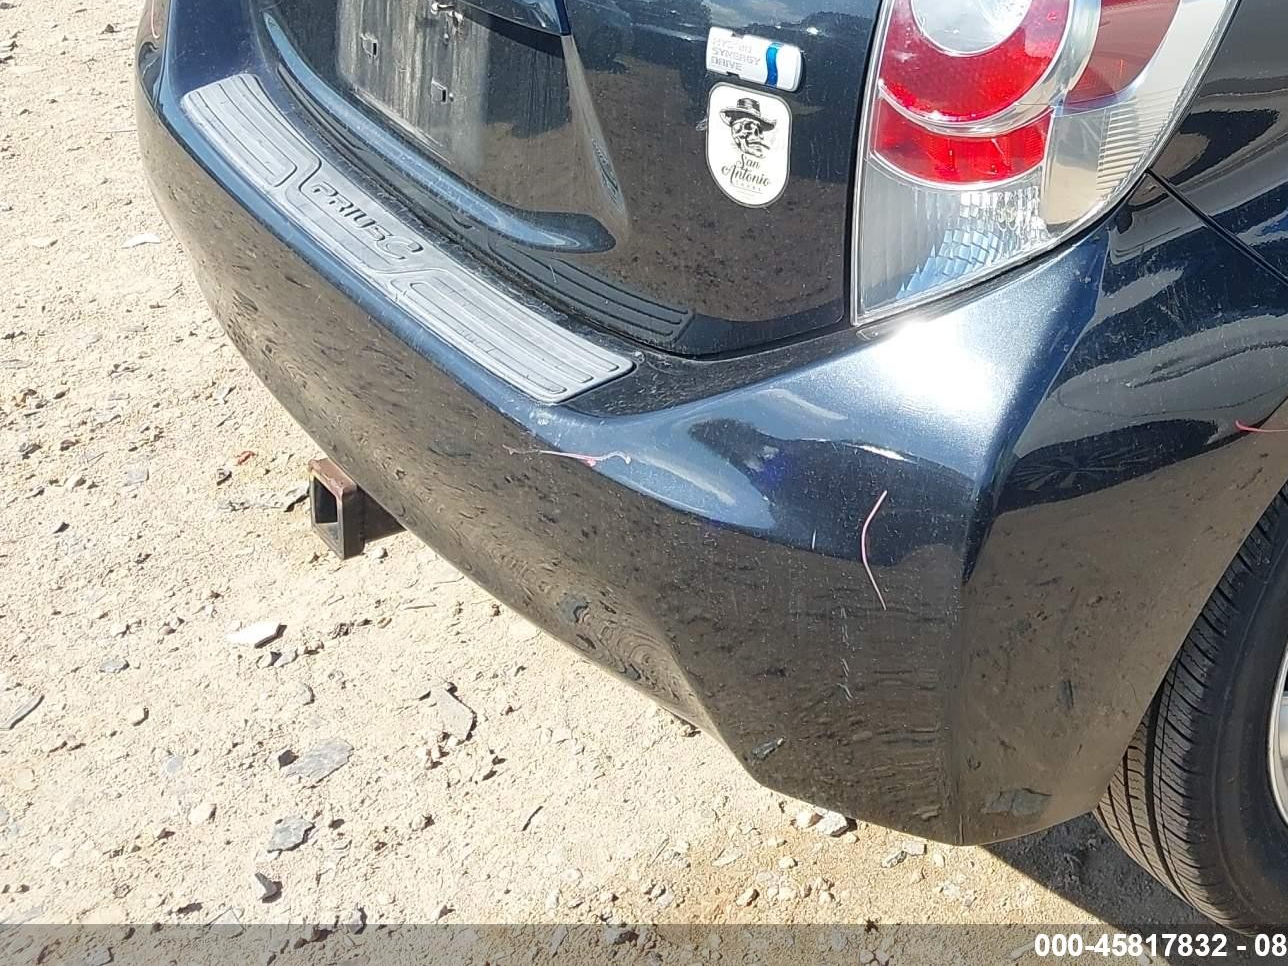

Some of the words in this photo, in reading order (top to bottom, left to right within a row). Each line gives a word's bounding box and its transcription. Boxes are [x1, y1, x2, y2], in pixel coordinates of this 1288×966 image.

[710, 55, 743, 72] DRIVE
[711, 46, 761, 66] SYNERGY
[735, 153, 761, 171] San
[720, 164, 771, 187] Antonio
